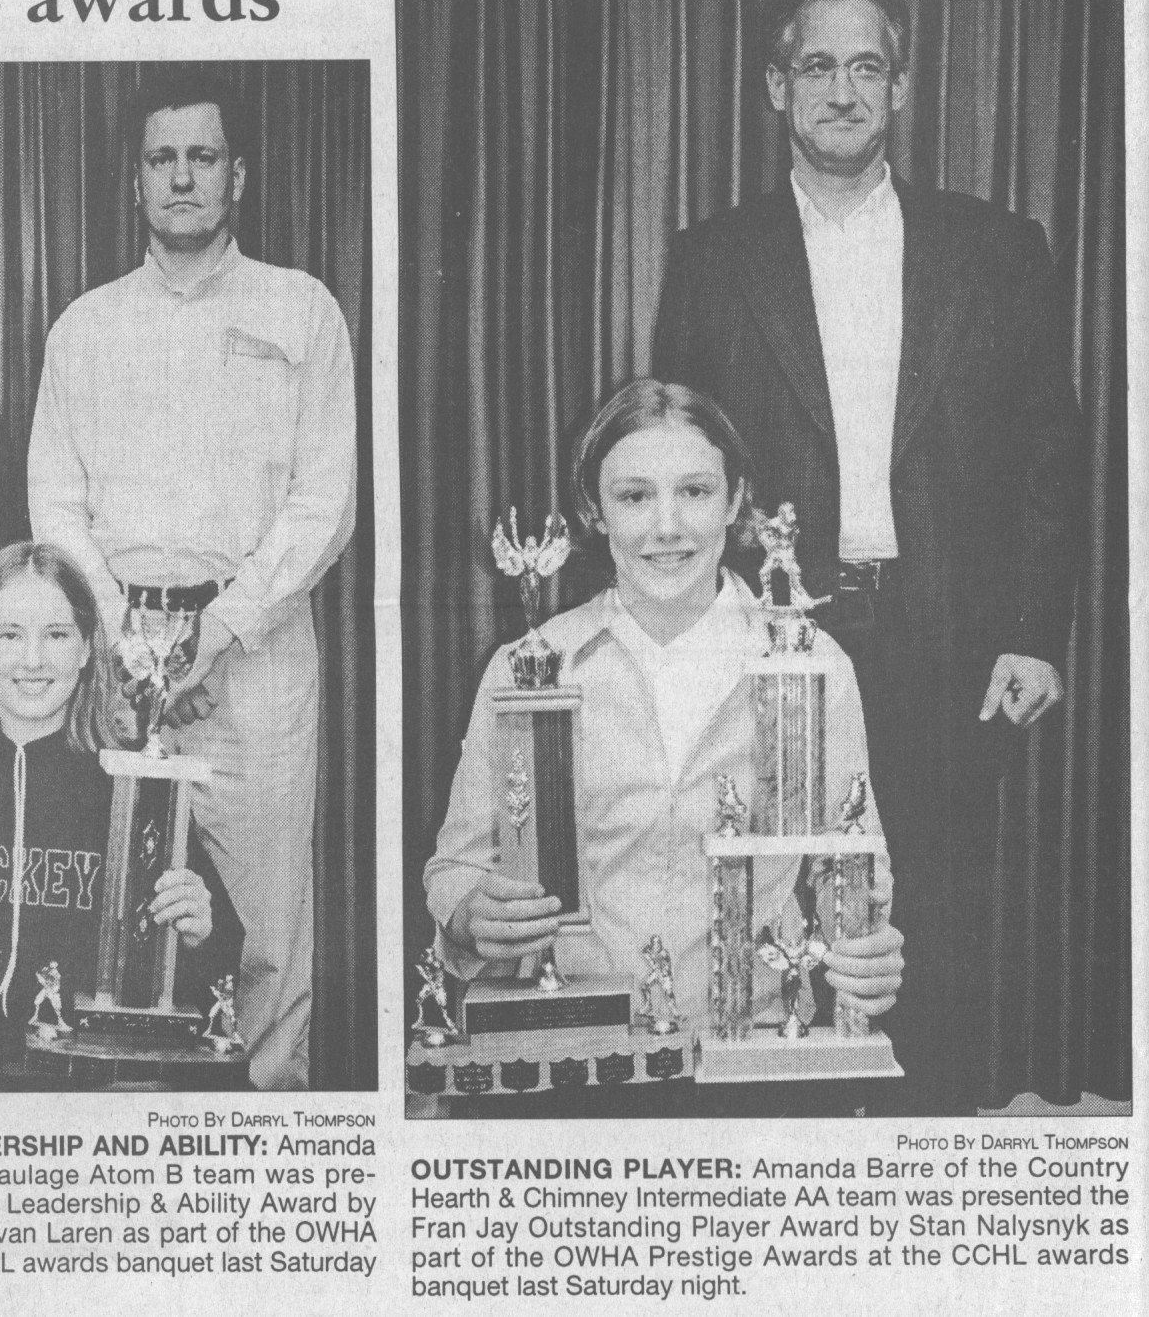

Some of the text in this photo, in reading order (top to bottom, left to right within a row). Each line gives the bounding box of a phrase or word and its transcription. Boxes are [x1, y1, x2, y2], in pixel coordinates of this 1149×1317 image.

[148, 1111, 375, 1128] PHOTO BY DARRYL THOMPSON
[92, 1135, 149, 1156] AND
[159, 1134, 267, 1156] ABILITY:
[277, 1134, 376, 1156] Amanda
[897, 1134, 1128, 1150] PHOTO BY DARRYL THOMPSON
[89, 1164, 154, 1185] Atom
[166, 1164, 183, 1184] B
[193, 1165, 254, 1184] team
[265, 1168, 314, 1184] was
[326, 1168, 375, 1189] pre-
[411, 1156, 1129, 1182] OUTSTANDING PLAYER: Amanda Barre of the Country
[412, 1185, 1129, 1213] Hearth & Chimney Intermediate AA team was presented the
[412, 1275, 746, 1301] banquet last Saturday night.
